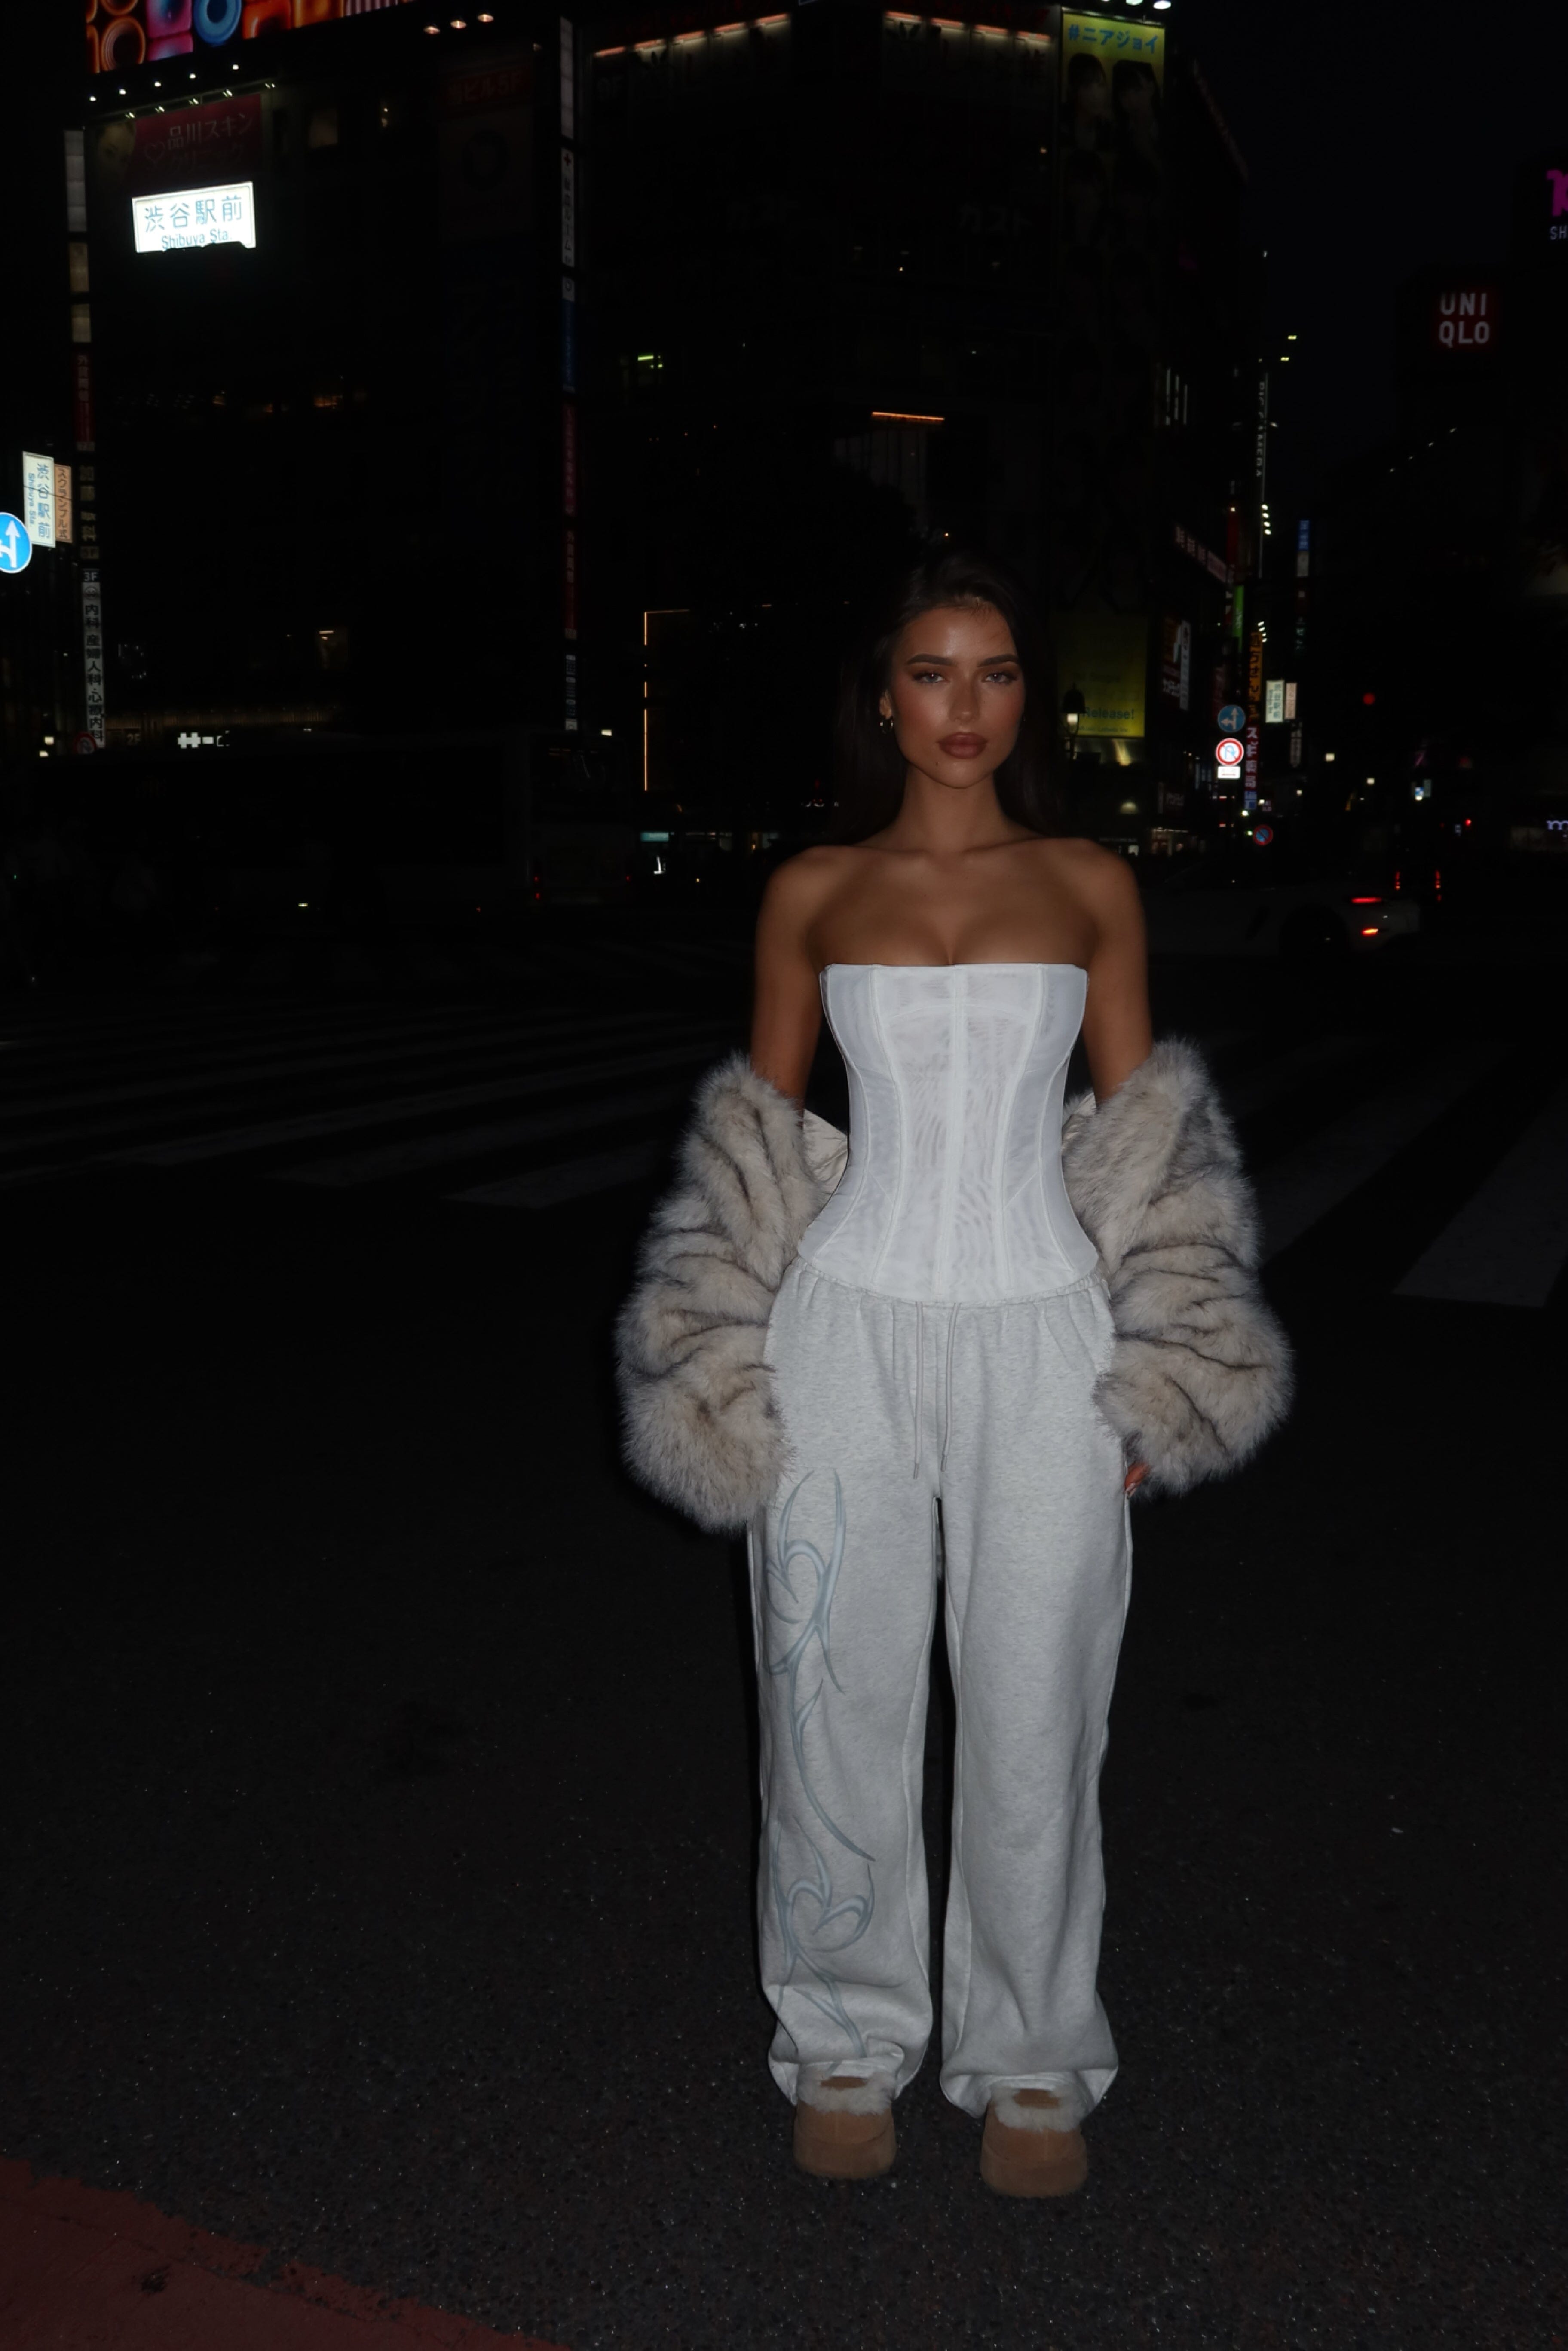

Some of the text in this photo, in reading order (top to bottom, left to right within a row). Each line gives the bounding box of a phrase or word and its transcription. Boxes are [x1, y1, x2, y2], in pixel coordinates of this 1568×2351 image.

[1068, 24, 1158, 54] #ニアジョイ
[169, 113, 252, 149] 品川スキン
[145, 196, 242, 232] 渋谷駅前
[162, 234, 205, 249] Shibuya
[1440, 293, 1487, 316] UNI
[1439, 321, 1490, 348] QLO
[37, 463, 50, 539] 渋谷駅前
[84, 571, 98, 581] 3F
